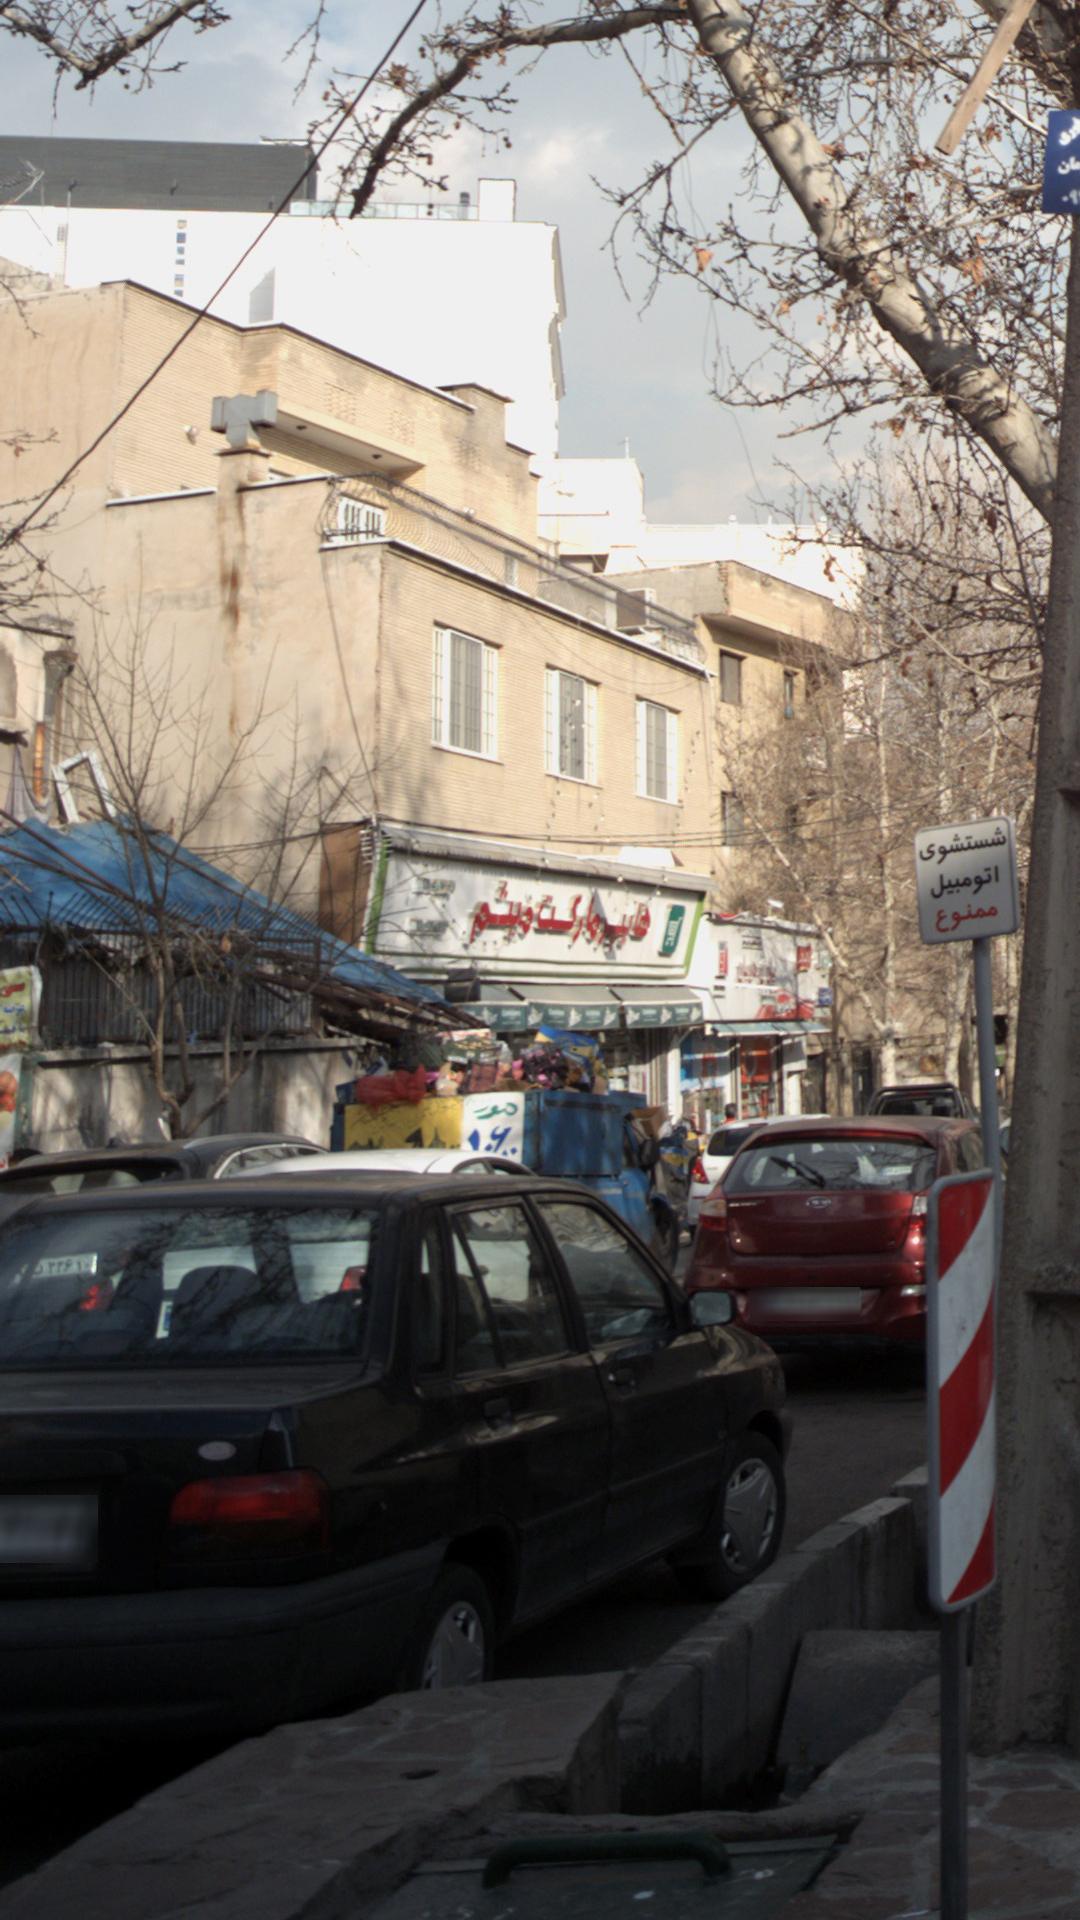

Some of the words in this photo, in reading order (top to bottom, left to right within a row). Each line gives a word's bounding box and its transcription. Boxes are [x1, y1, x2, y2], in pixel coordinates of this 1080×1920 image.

[919, 826, 1007, 864] شستشوی
[930, 865, 1000, 899] اتومبیل
[935, 903, 999, 932] ممنوع
